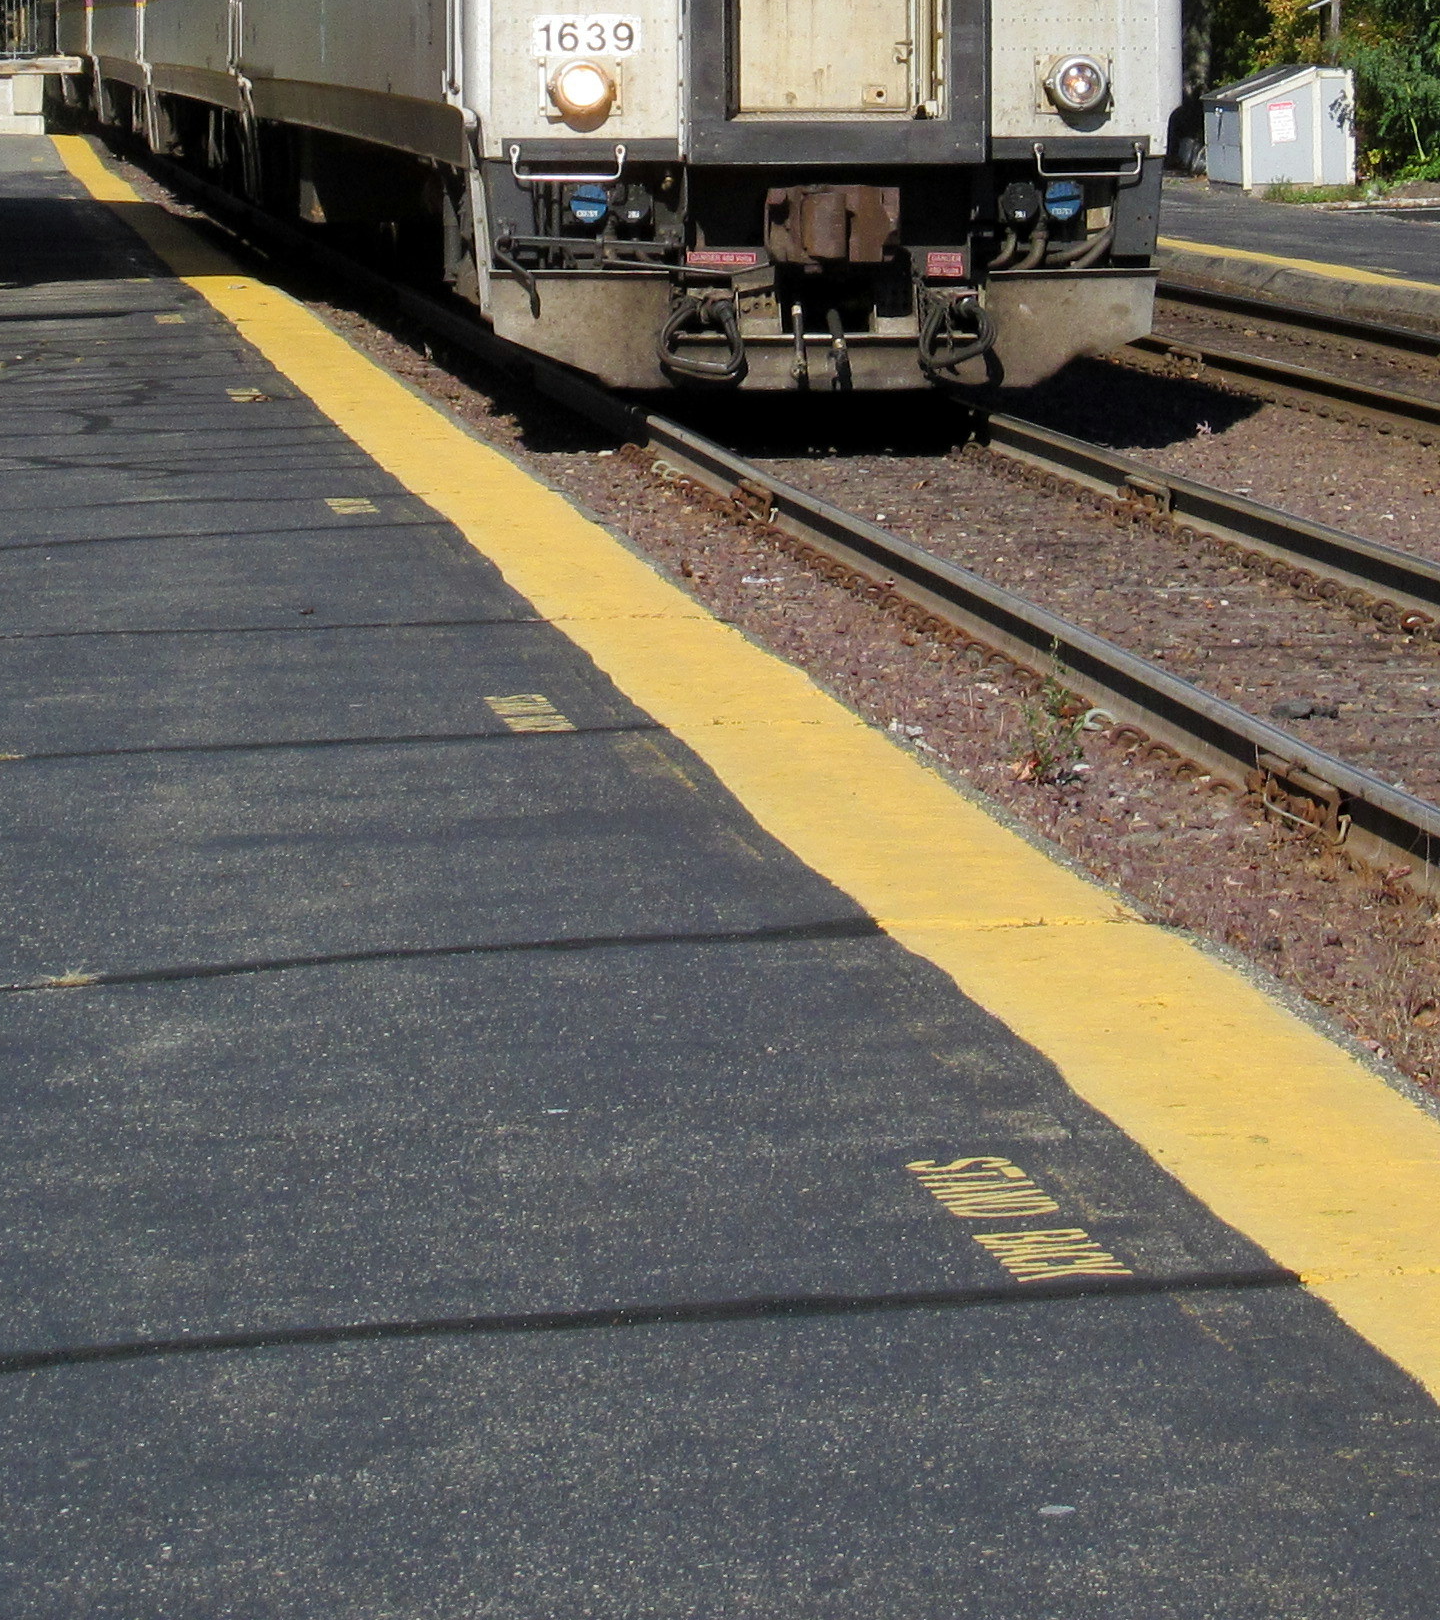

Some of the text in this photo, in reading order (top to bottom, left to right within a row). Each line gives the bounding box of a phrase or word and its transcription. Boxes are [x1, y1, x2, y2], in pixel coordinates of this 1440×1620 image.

[538, 22, 634, 51] 1639
[905, 1156, 1134, 1283] STAND BACK
